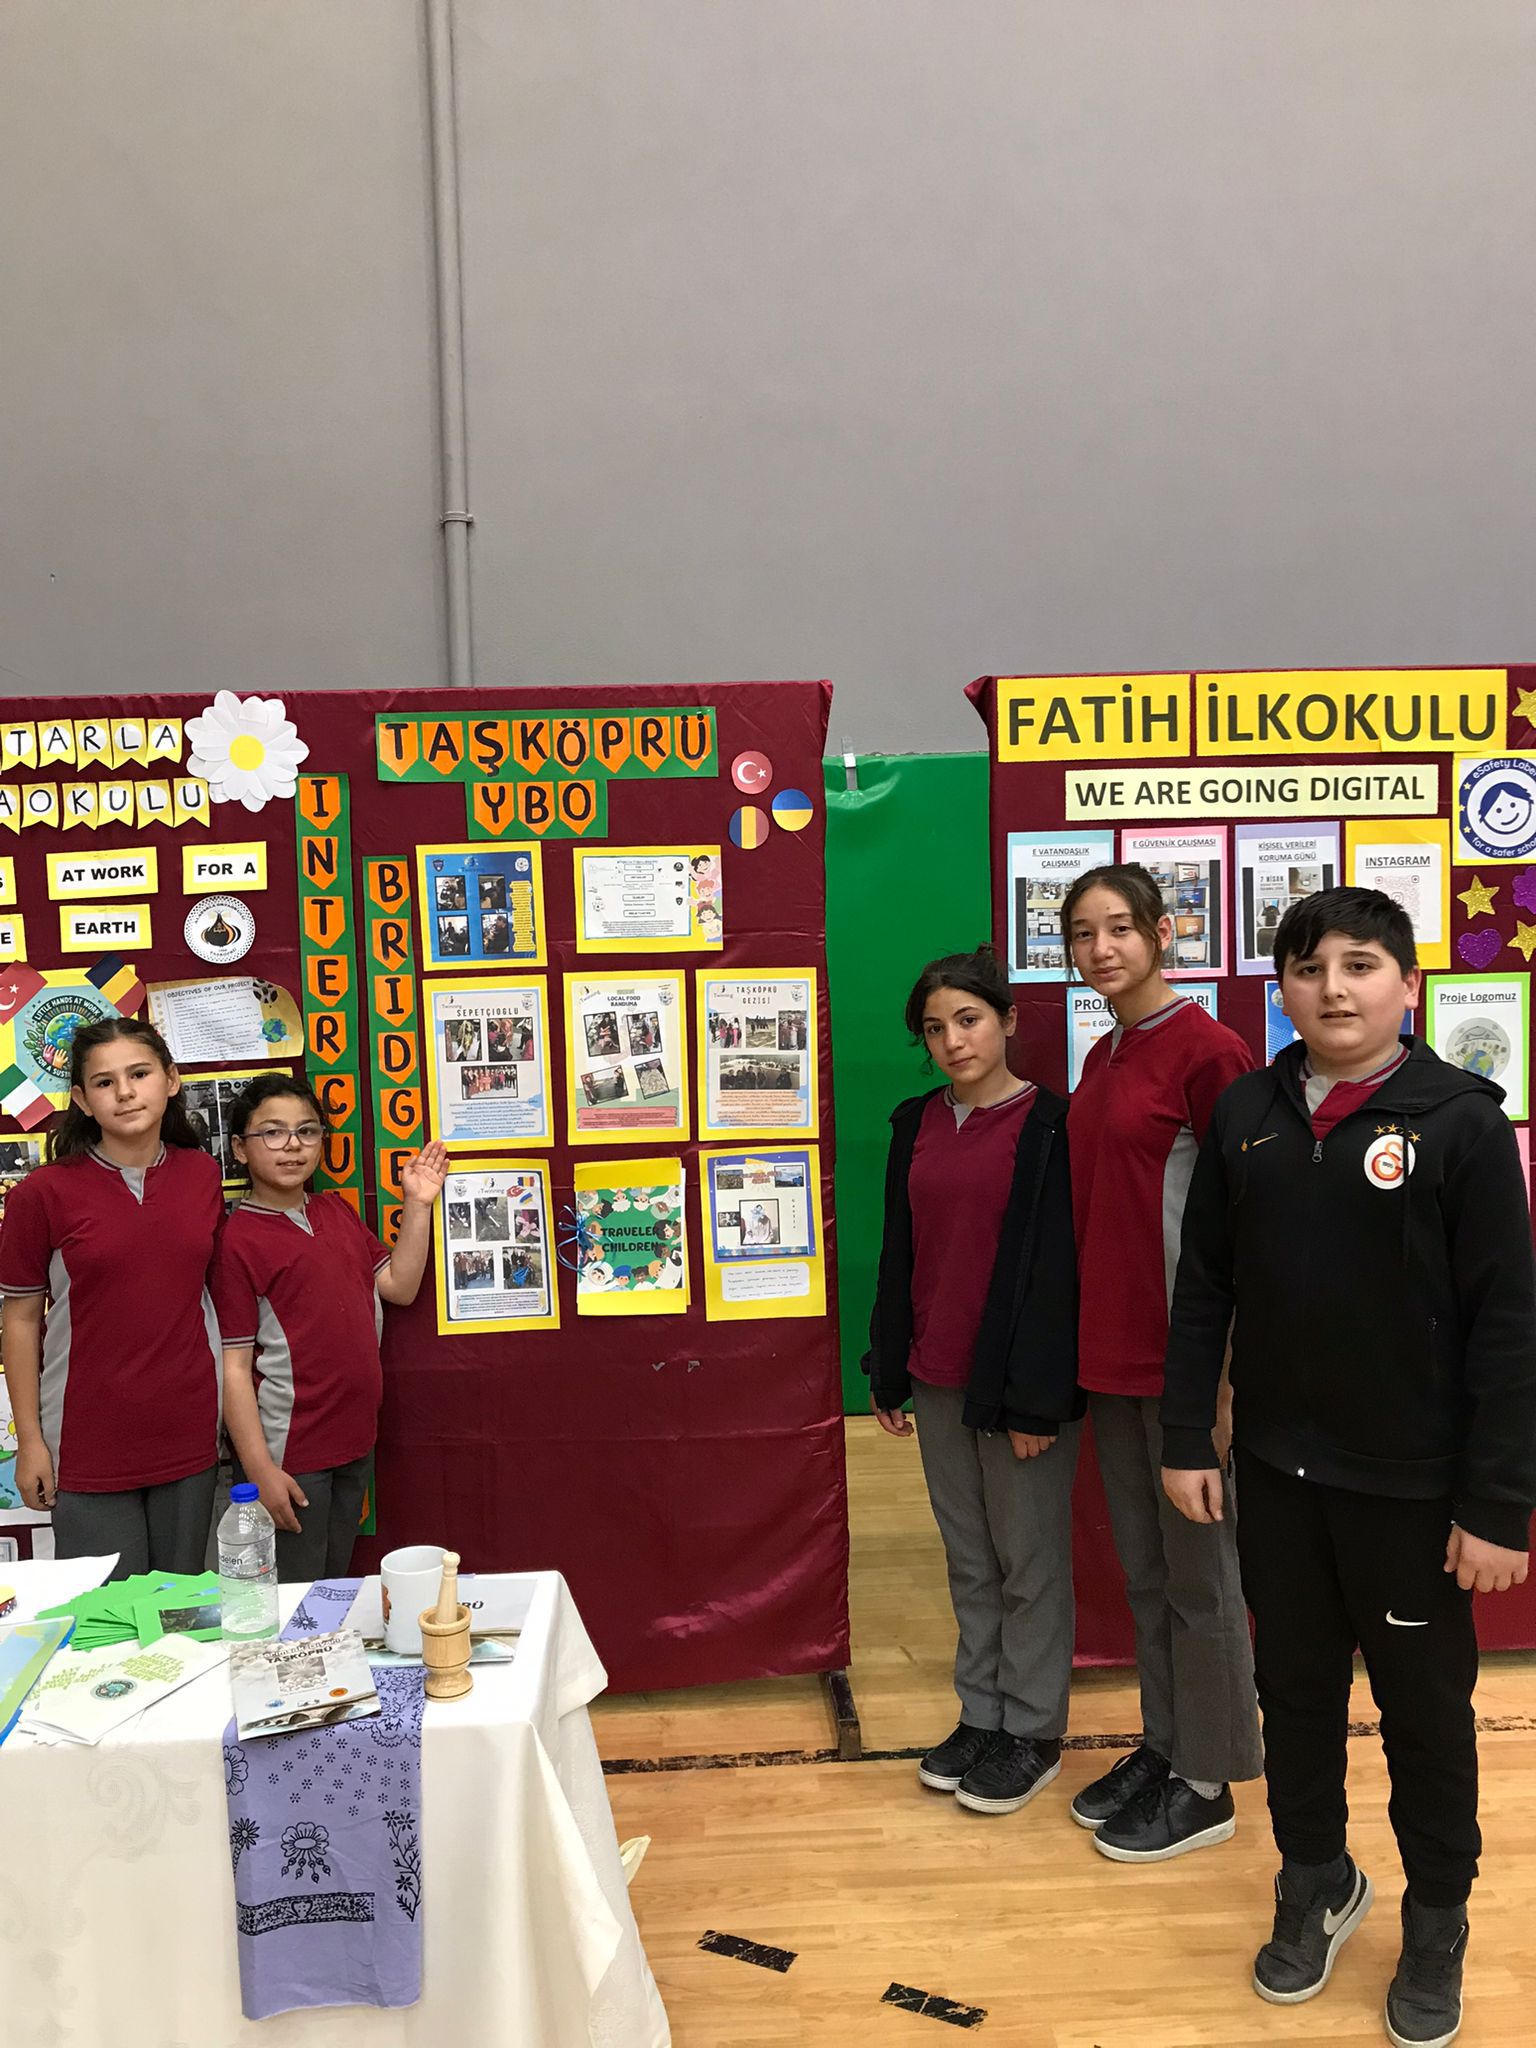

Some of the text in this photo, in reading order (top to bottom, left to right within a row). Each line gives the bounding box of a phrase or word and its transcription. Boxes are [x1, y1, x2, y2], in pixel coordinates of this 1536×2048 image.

[1008, 682, 1497, 746] FATİH İLKOKULU
[10, 725, 176, 757] TARLA
[385, 714, 706, 777] TAŞKÖPRÜ
[1472, 759, 1510, 779] eSafety
[1075, 775, 1425, 807] WE ARE GOING DIGITAL
[480, 782, 591, 825] YBO
[1032, 848, 1037, 856] E
[1133, 840, 1137, 848] E
[1472, 836, 1485, 849] for
[1492, 848, 1516, 857] safer
[1517, 837, 1536, 855] scho
[1258, 853, 1293, 862] KORUMA
[1365, 856, 1431, 866] INSTAGRAM
[62, 864, 145, 883] AT WORK
[197, 861, 256, 876] FOR A
[75, 921, 136, 935] EARTH
[308, 778, 352, 1196] INTERCU
[1074, 998, 1109, 1011] PROJ
[1440, 992, 1517, 1004] Proje Logomuz
[1098, 1019, 1116, 1027] GÜV
